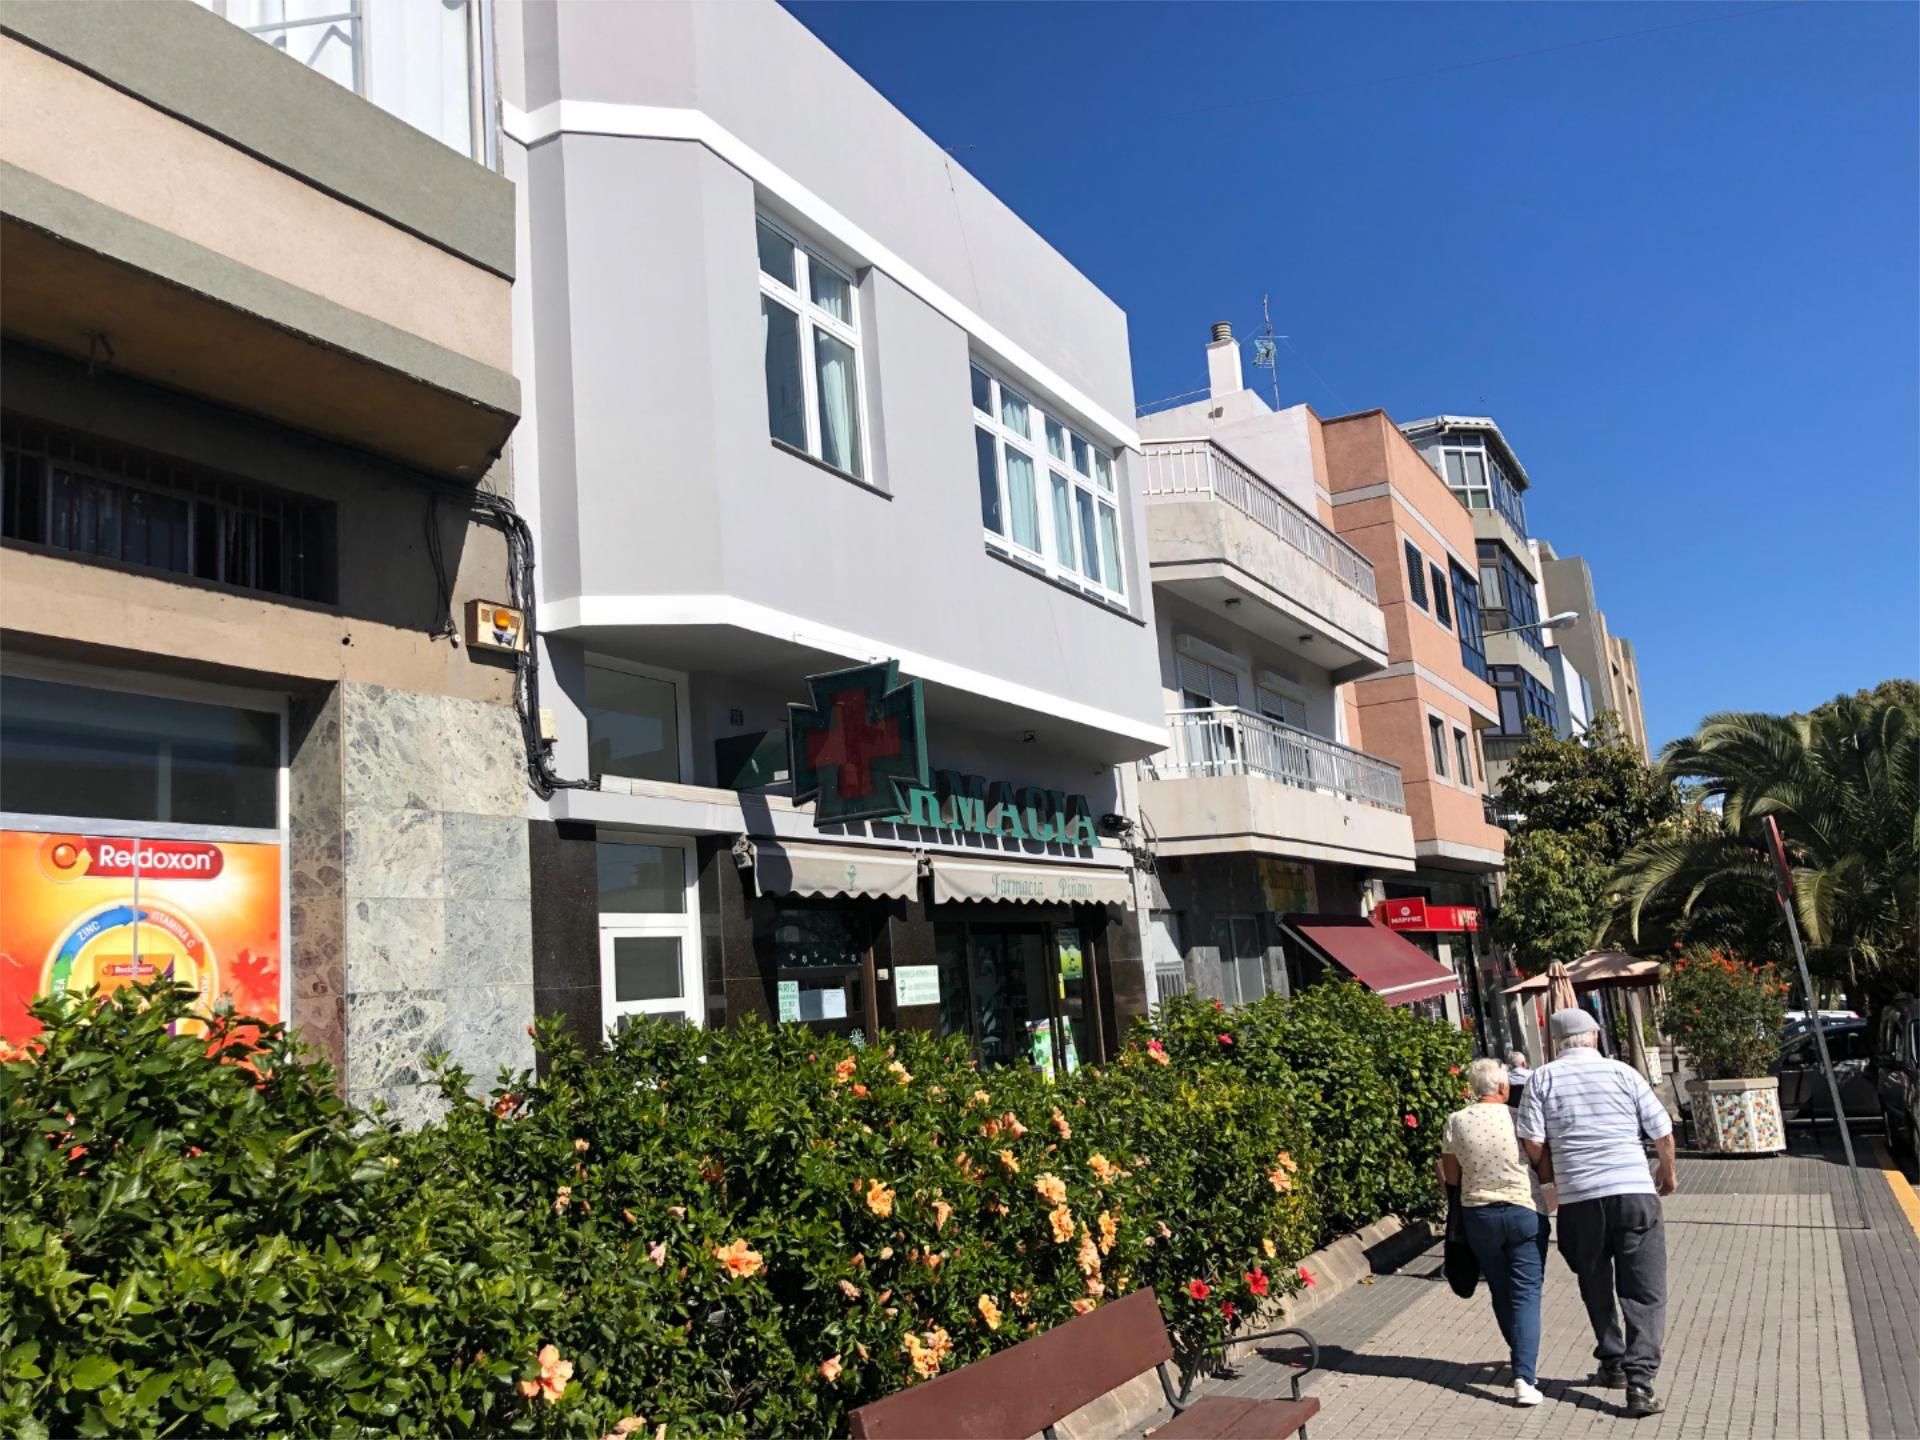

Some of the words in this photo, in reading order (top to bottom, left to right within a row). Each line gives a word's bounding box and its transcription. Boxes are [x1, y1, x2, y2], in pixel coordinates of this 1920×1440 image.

[100, 845, 211, 870] Redoxon
[992, 872, 1043, 897] Farmacia
[77, 921, 100, 941] ZINC
[152, 910, 189, 938] VITAMINA
[186, 939, 196, 949] C
[1391, 915, 1423, 924] MAPFRE
